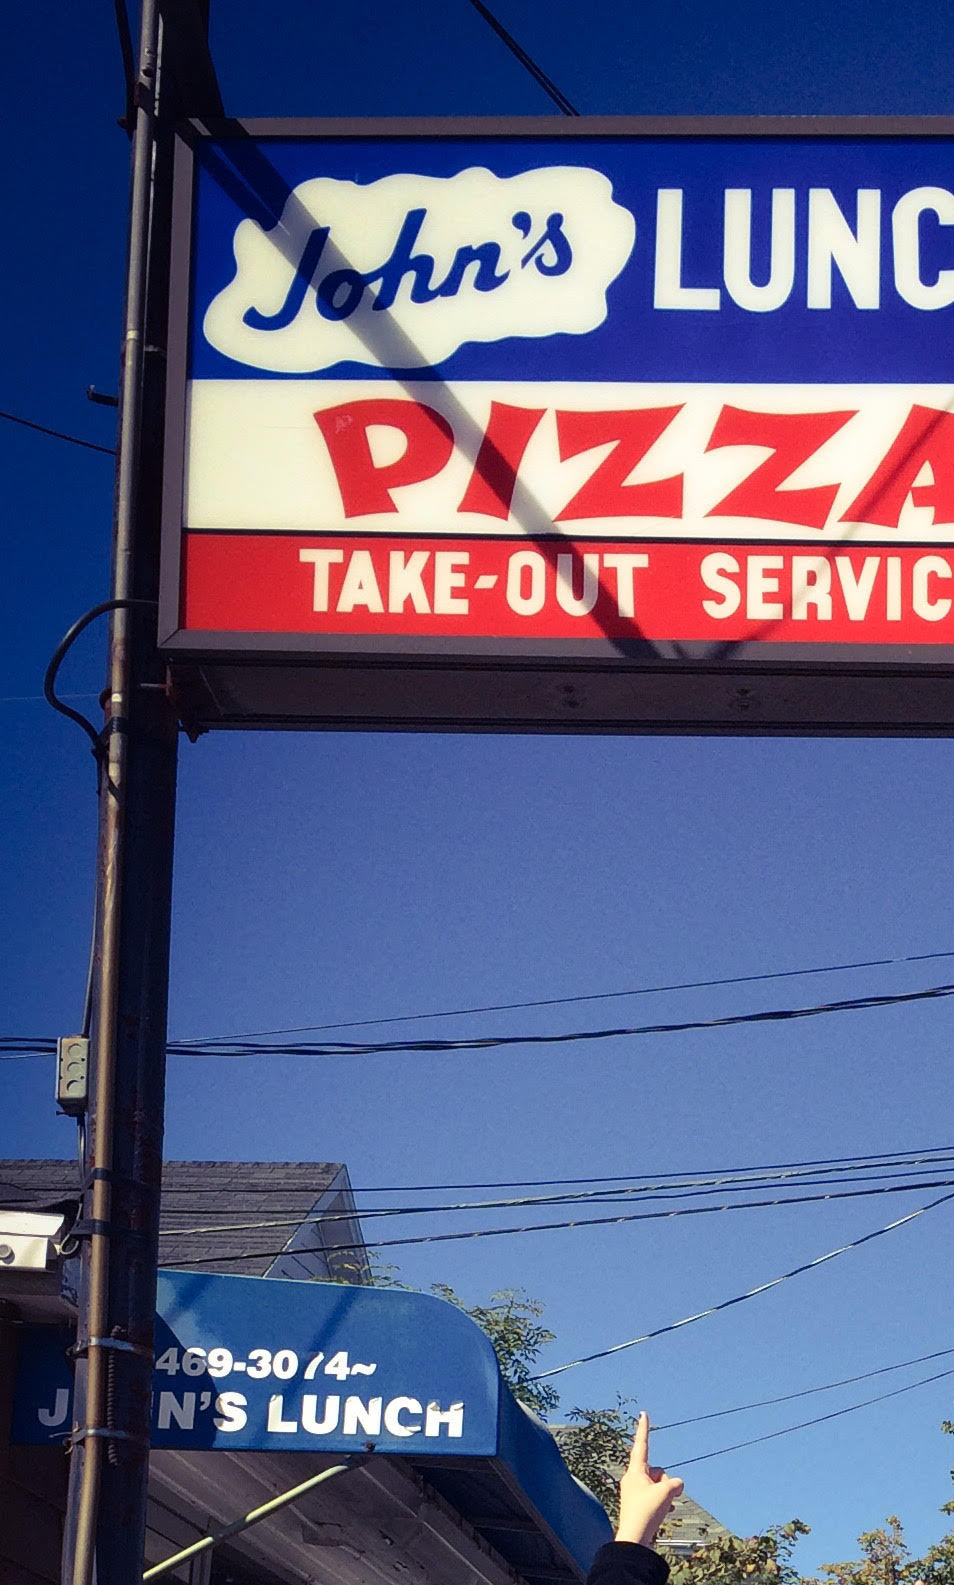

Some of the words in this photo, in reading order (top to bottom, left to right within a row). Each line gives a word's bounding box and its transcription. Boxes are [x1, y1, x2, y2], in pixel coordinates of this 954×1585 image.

[242, 207, 573, 331] John's
[299, 547, 649, 617] TAKE-OUT
[38, 1388, 248, 1433] JN'S
[267, 1394, 465, 1439] LUNCH
